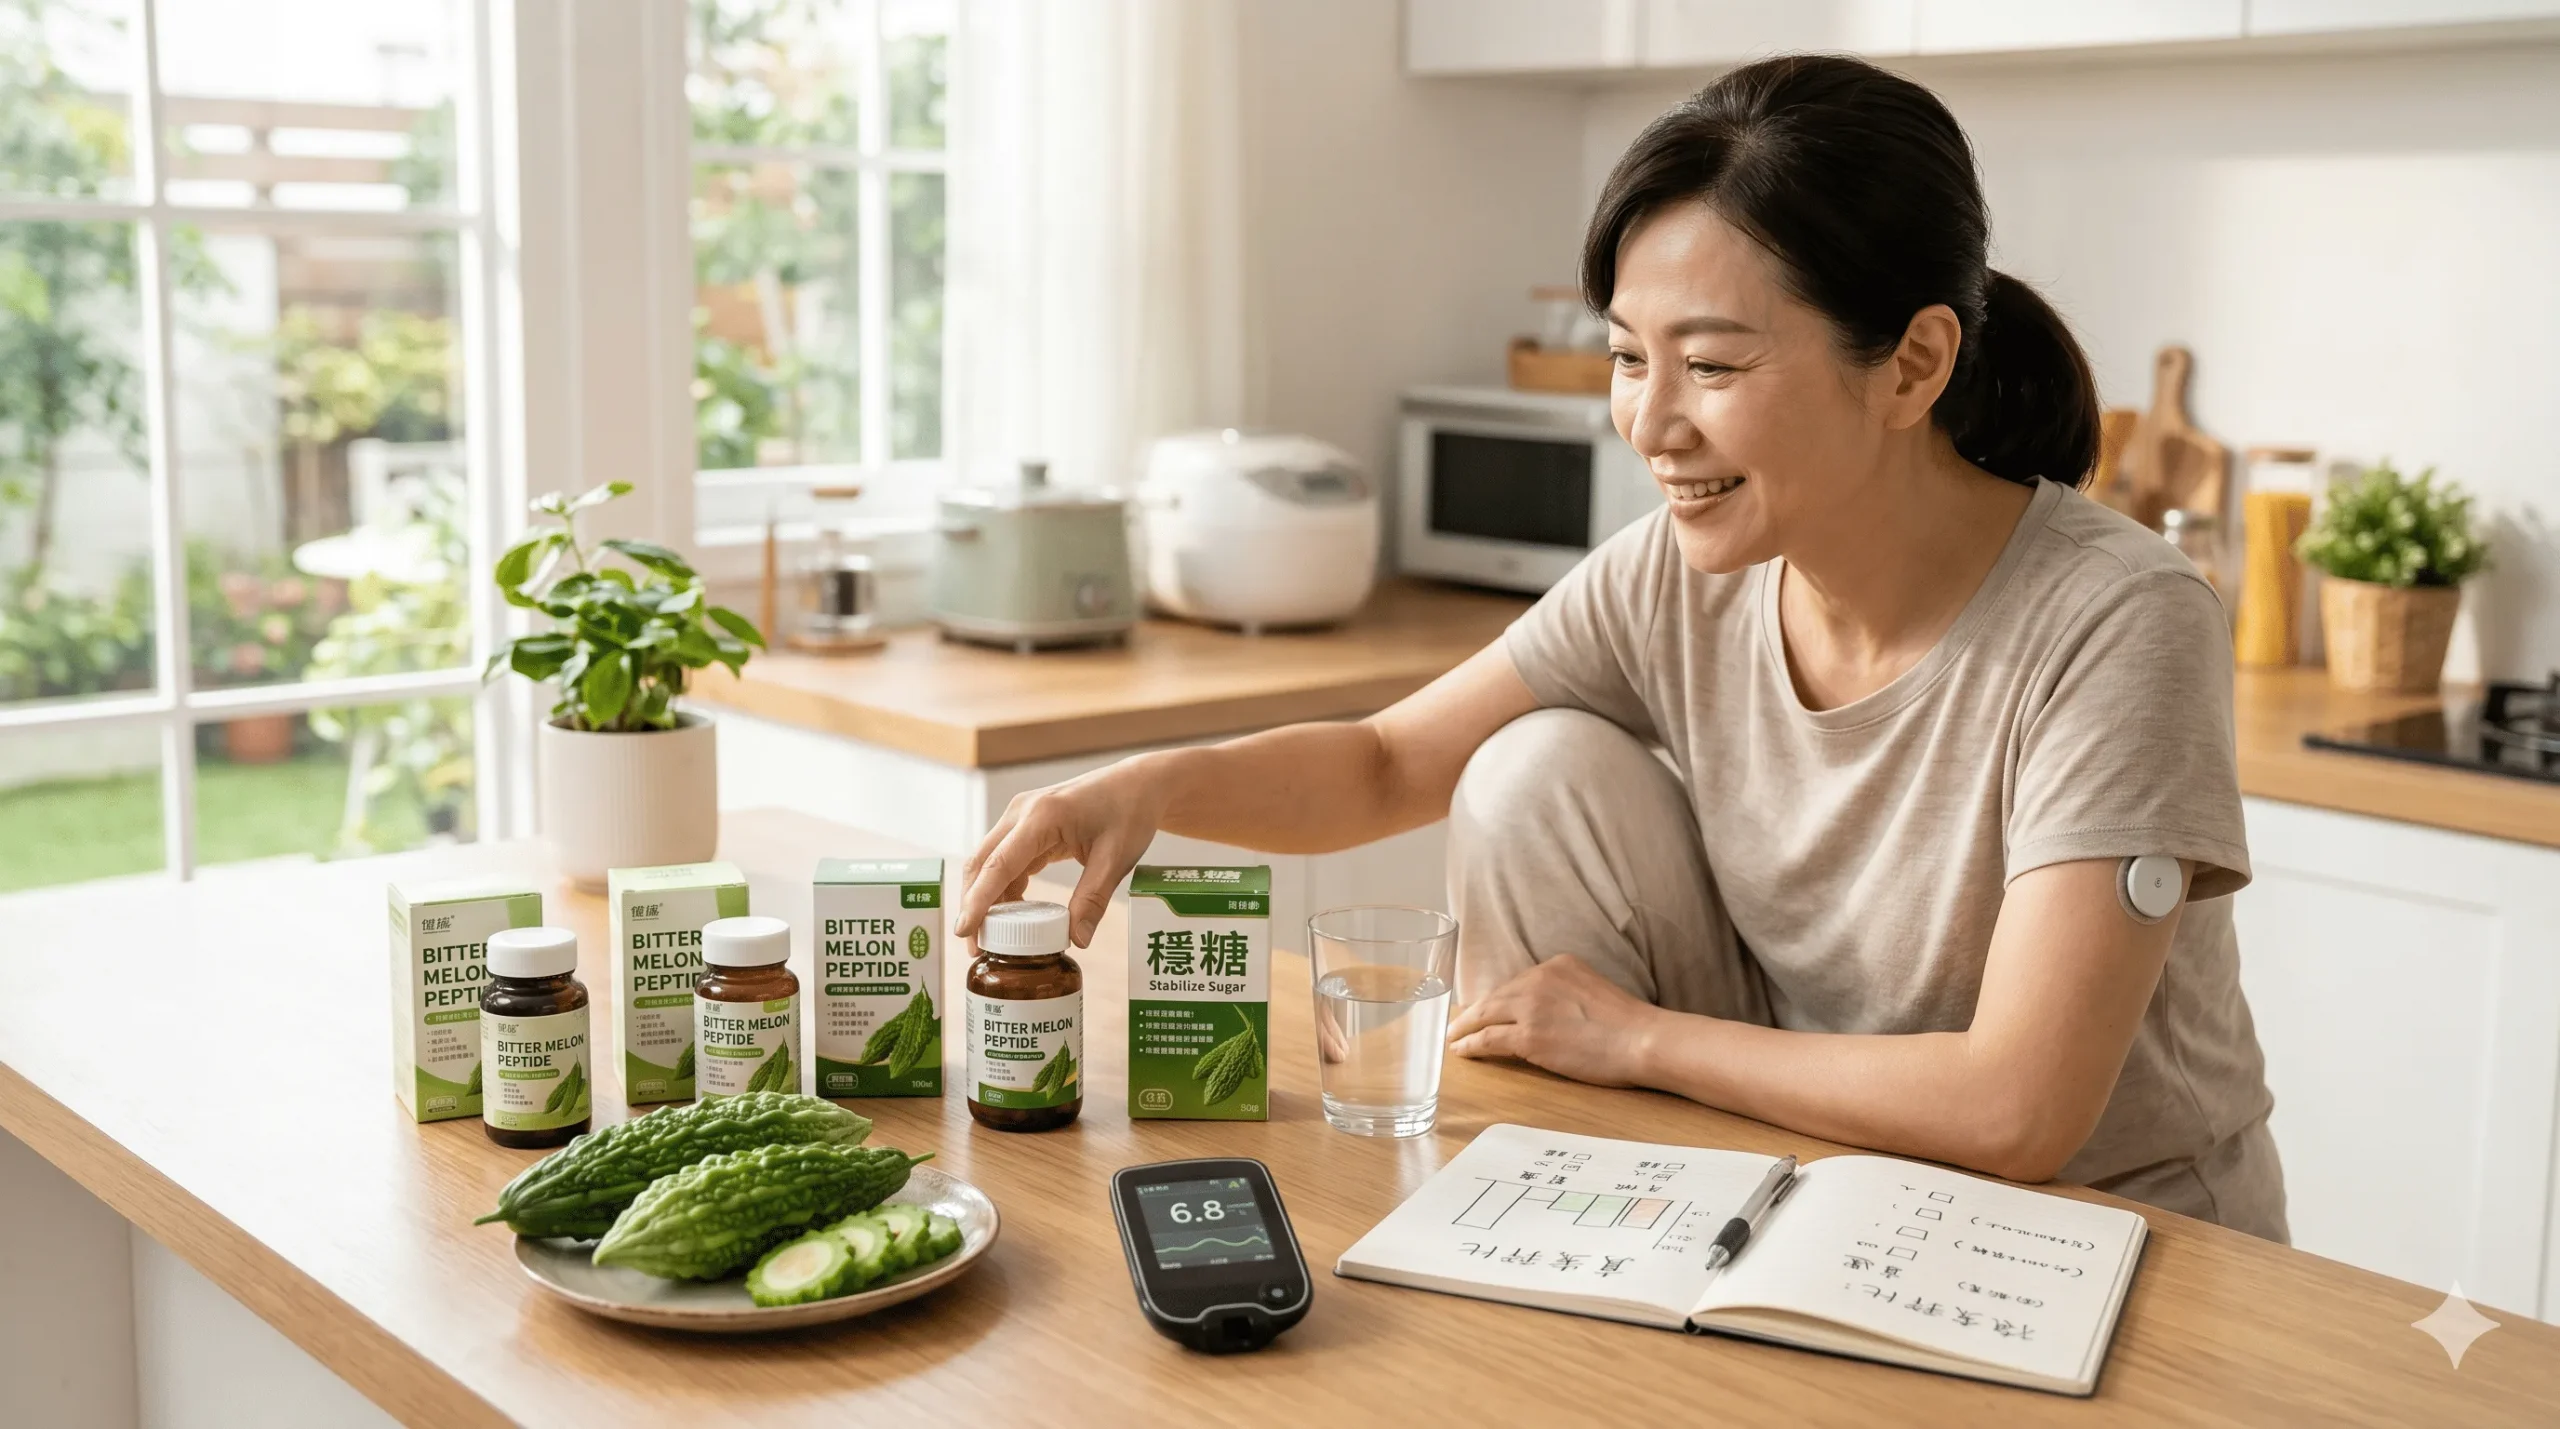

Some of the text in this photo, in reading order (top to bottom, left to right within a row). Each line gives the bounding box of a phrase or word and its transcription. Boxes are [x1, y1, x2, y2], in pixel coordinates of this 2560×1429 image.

[825, 919, 895, 935] BITTER
[633, 930, 702, 949] BITTER
[825, 940, 895, 956] MELON
[633, 951, 703, 970] MELON
[1147, 930, 1249, 977] 穩糖
[826, 961, 910, 978] PEPTIDE
[634, 972, 702, 991] PEPTI
[1149, 980, 1246, 995] Stabilize Sugar
[425, 986, 481, 1008] PEPTI
[704, 1013, 790, 1031] BITTER MELON
[984, 1017, 1073, 1034] BITTER MELON
[498, 1033, 584, 1053] BITTER MELON
[704, 1030, 755, 1045] PEPTIDE
[985, 1034, 1038, 1049] PEPTIDE
[498, 1054, 552, 1067] PEPTIDE
[1170, 1200, 1225, 1223] 6.8
